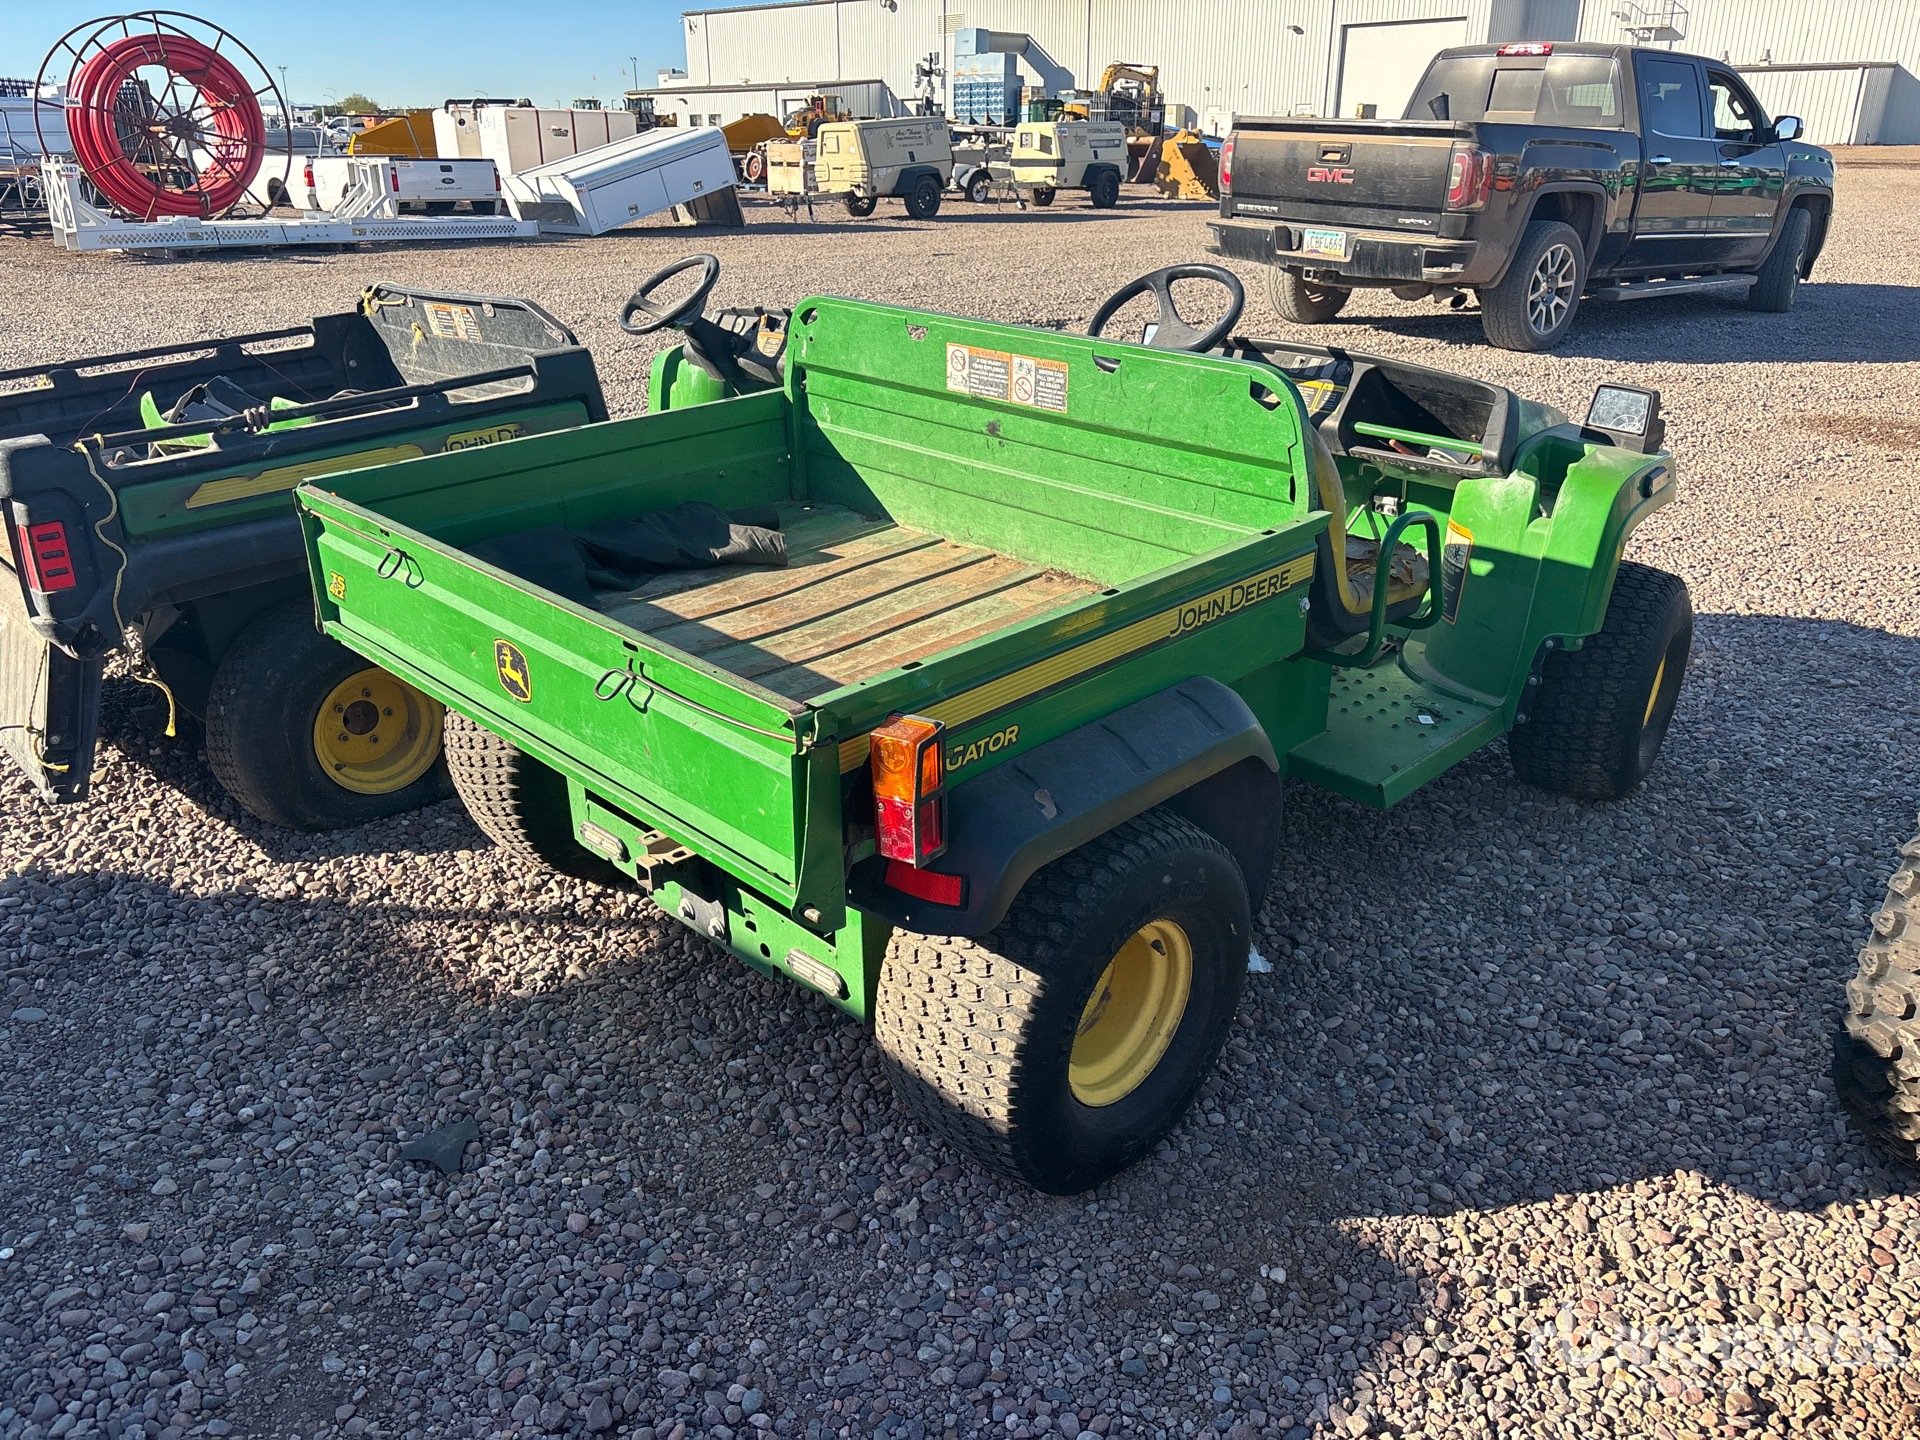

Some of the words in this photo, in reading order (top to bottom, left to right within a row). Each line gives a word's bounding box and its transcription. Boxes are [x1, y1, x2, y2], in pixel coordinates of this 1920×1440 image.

[925, 123, 944, 132] C-109
[1307, 167, 1355, 184] GMC
[1237, 203, 1279, 213] SIERRA
[1309, 235, 1342, 252] CBF4669
[1169, 594, 1226, 637] JOHN
[1229, 568, 1291, 611] DEERE
[945, 724, 1020, 772] GATOR
